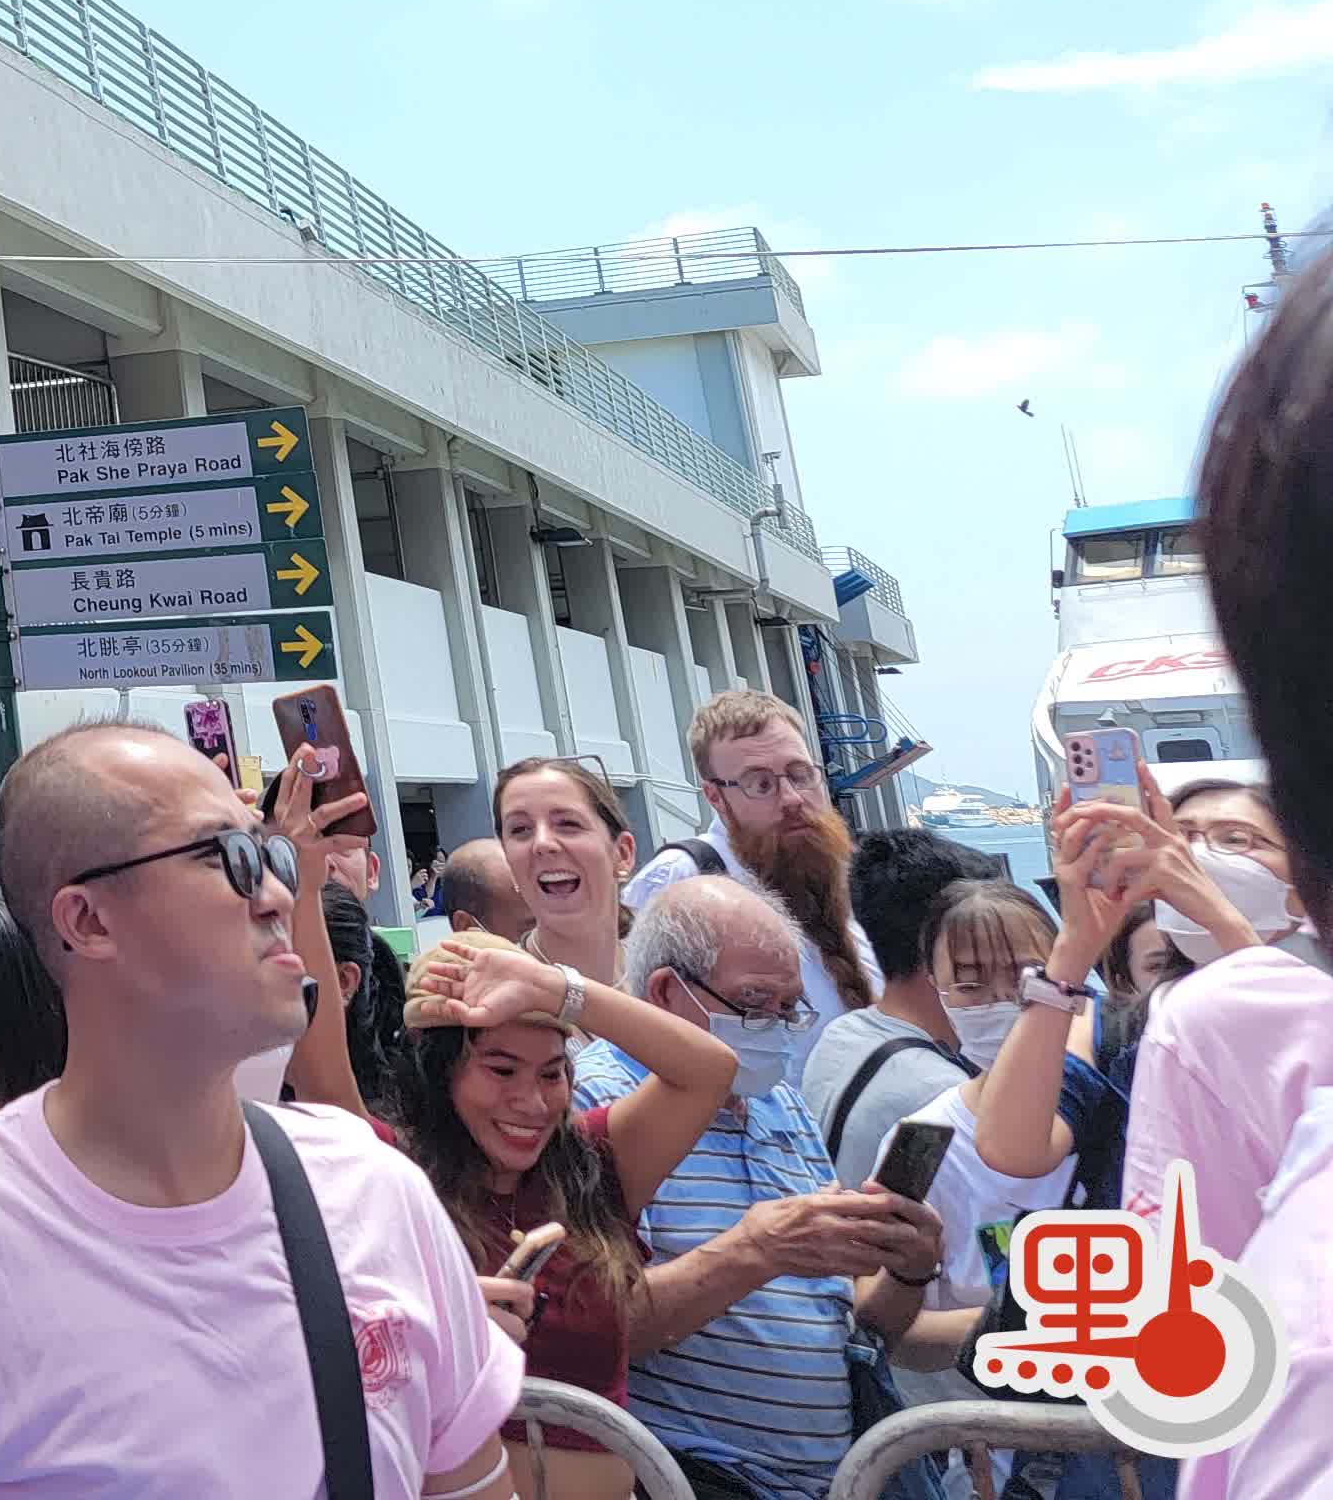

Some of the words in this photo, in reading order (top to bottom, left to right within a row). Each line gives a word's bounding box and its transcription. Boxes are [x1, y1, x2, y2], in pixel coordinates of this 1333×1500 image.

[55, 435, 167, 463] 北社海傍路
[57, 468, 90, 485] Pak
[96, 464, 131, 481] She
[137, 460, 188, 480] Praya
[195, 454, 242, 472] Road
[64, 532, 93, 548] Pak
[99, 530, 121, 546] Tai
[126, 525, 183, 546] Temple
[189, 524, 206, 542] (5
[208, 520, 254, 539] mins)
[70, 568, 137, 592] 長貴路
[73, 594, 143, 614] Cheung
[149, 591, 194, 609] Kwai
[200, 587, 249, 605] Road
[79, 666, 110, 681] North
[113, 664, 158, 679] Lookout
[160, 662, 206, 678] Pavilion
[209, 661, 228, 677] (35
[229, 659, 263, 677] mins)
